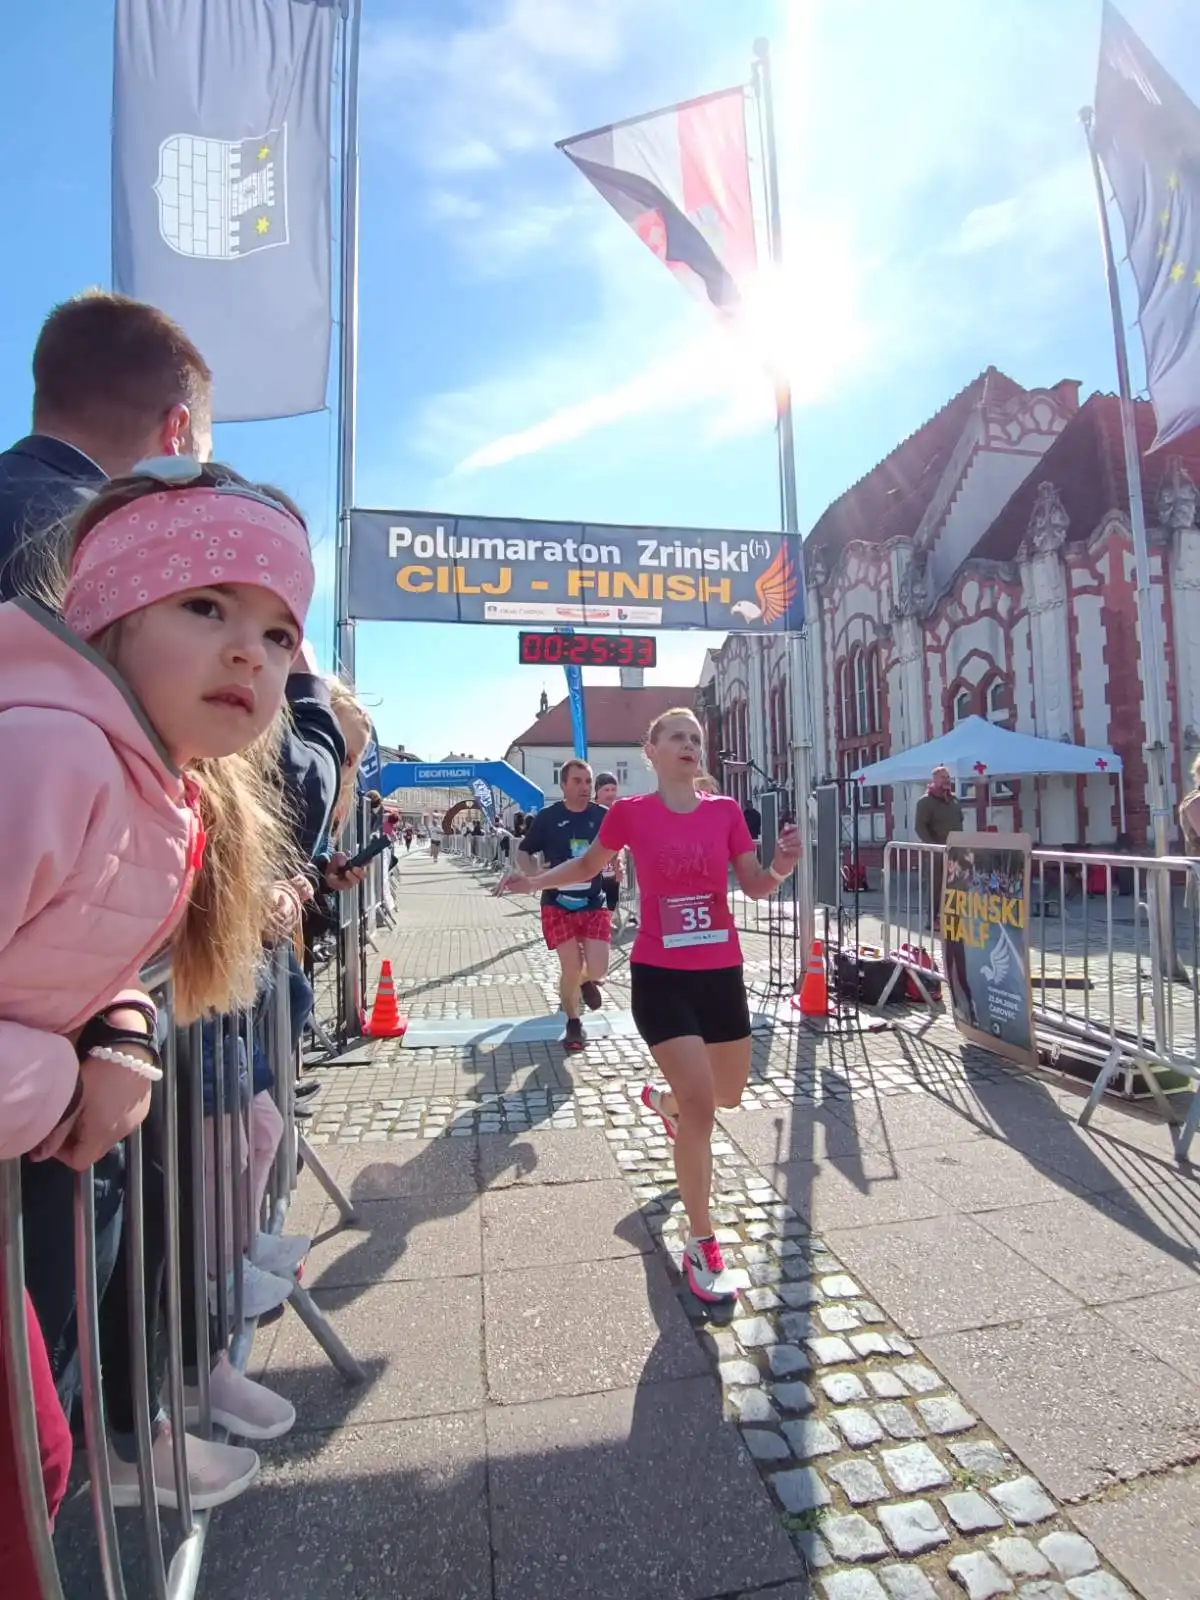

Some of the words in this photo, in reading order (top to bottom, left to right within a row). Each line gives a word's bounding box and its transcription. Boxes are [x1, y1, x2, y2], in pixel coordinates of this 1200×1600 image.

[389, 526, 620, 564] Polumaraton
[396, 565, 511, 594] CILJ
[567, 569, 731, 604] FINISH
[523, 634, 655, 665] 00:25:33
[418, 768, 471, 778] DECATHLON
[681, 906, 712, 931] 35
[944, 888, 1024, 929] ZRINSKI
[943, 914, 990, 949] HALF
